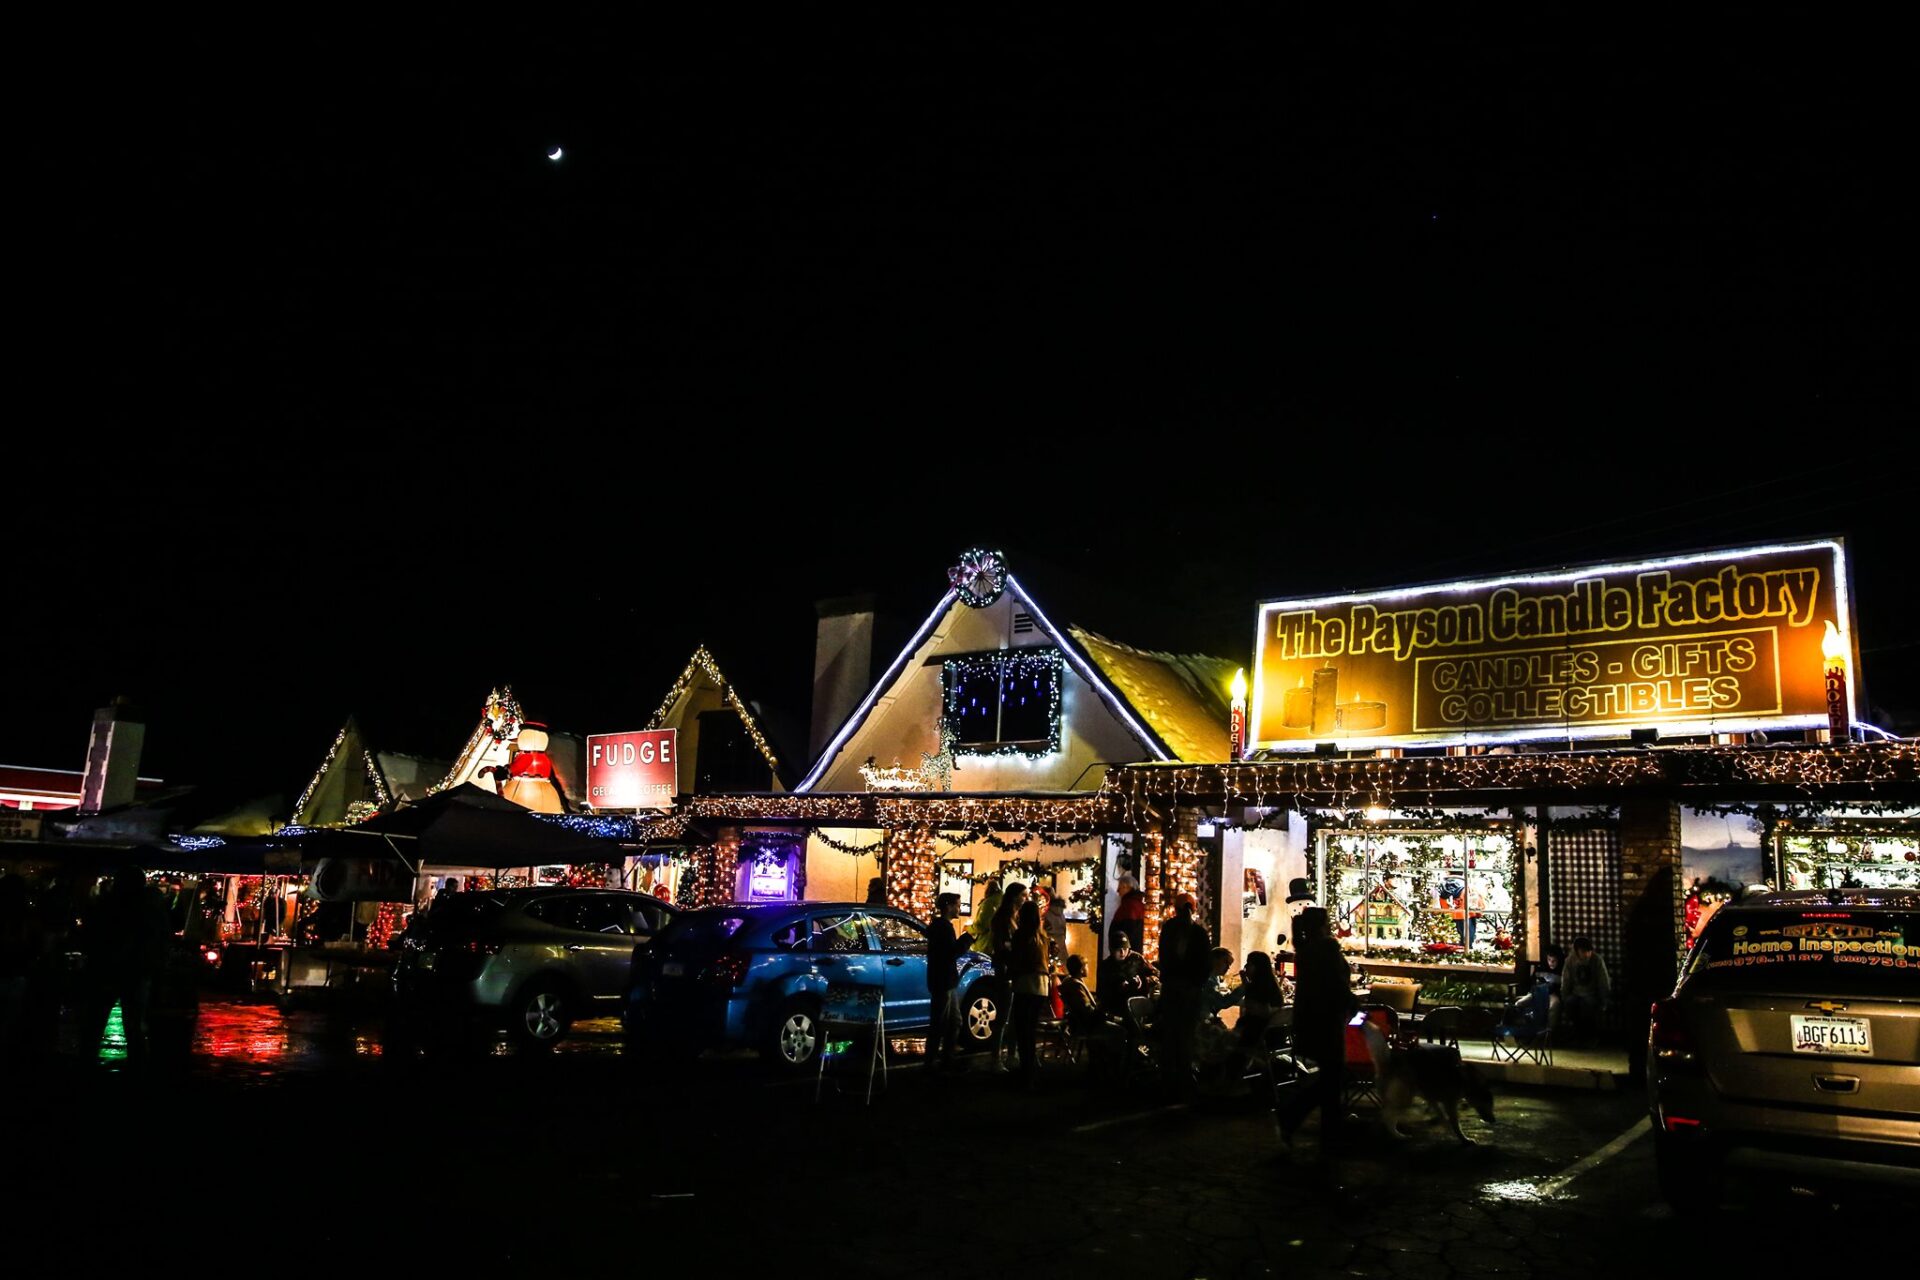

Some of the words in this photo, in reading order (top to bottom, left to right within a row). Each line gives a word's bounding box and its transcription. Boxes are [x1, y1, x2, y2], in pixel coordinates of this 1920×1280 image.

[1278, 609, 1345, 660] The
[1349, 604, 1484, 661] Payson
[1489, 577, 1632, 642] Candle
[1637, 565, 1820, 628] Factory
[1432, 651, 1599, 692] CANDLES
[1632, 637, 1757, 678] GIFTS
[1440, 676, 1742, 723] COLLECTIBLES
[593, 740, 670, 767] FUDGE
[1733, 941, 1793, 955] Home
[1799, 937, 1920, 958] Inspection
[1803, 1025, 1866, 1046] BGF6113
